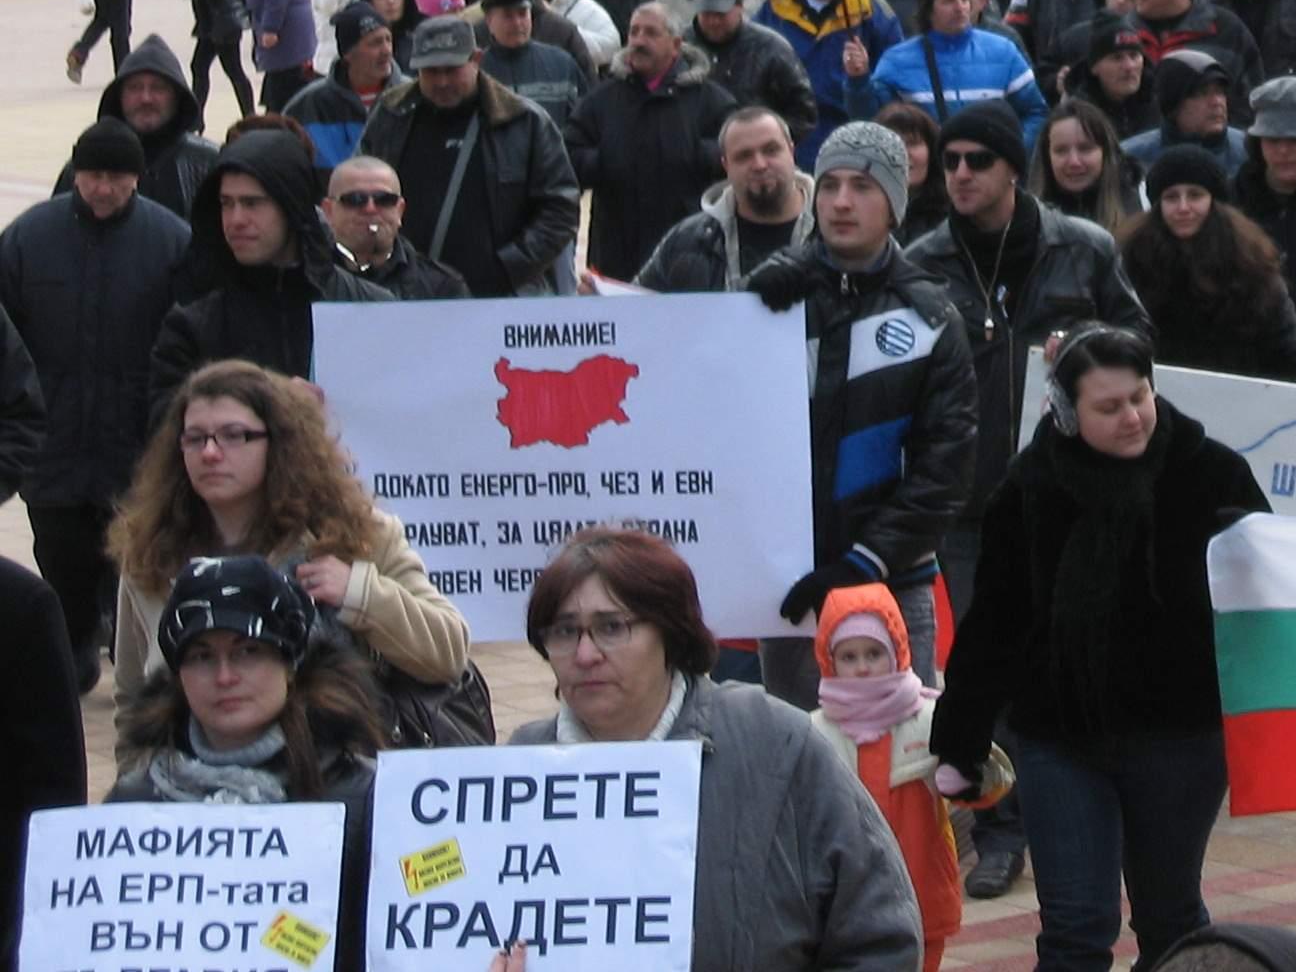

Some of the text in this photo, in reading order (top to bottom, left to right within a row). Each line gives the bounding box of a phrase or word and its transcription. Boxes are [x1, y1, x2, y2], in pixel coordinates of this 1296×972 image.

[503, 321, 616, 348] ВНИМАНИЕ!
[373, 470, 714, 500] ДОКАТО ЕНЕРГО-ПРО, ЧЕЗ И ЕВН
[404, 520, 487, 549] РЛУВАТ,
[497, 521, 523, 546] ЗА
[428, 568, 483, 596] ЯВЕН
[410, 771, 661, 825] СПРЕТЕ
[75, 826, 290, 860] МАФИЯТА
[498, 843, 562, 885] ДА
[50, 873, 310, 910] НА ЕРП-тата
[90, 920, 184, 953] ВЪН
[198, 921, 259, 953] ОТ
[385, 895, 672, 957] КРАДЕТЕ
